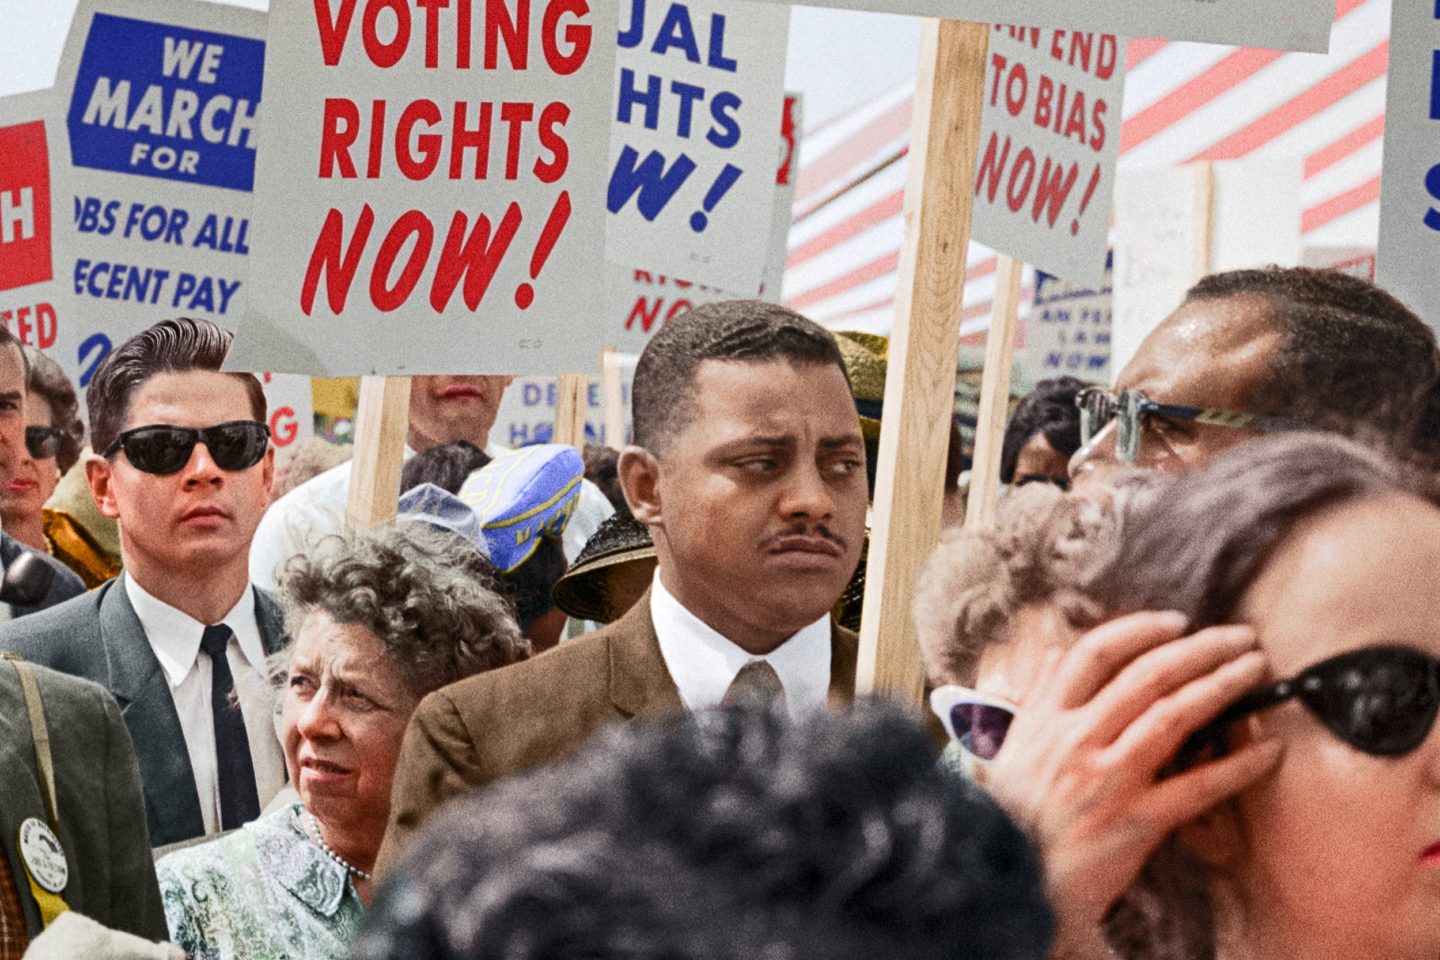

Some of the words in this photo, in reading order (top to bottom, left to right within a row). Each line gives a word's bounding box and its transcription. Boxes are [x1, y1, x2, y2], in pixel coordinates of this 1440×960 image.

[162, 36, 224, 85] WE
[1051, 29, 1117, 81] END
[82, 76, 261, 150] MARCH
[991, 53, 1028, 117] TO
[1034, 72, 1107, 153] BIAS
[129, 143, 200, 175] FOR
[317, 97, 571, 185] RIGHTS
[974, 131, 1101, 236] NOW!
[75, 196, 121, 236] BS
[123, 203, 189, 246] FOR
[192, 213, 250, 256] ALL
[300, 189, 572, 317] NOW!
[74, 258, 170, 305] ECENT
[171, 272, 242, 315] PAY
